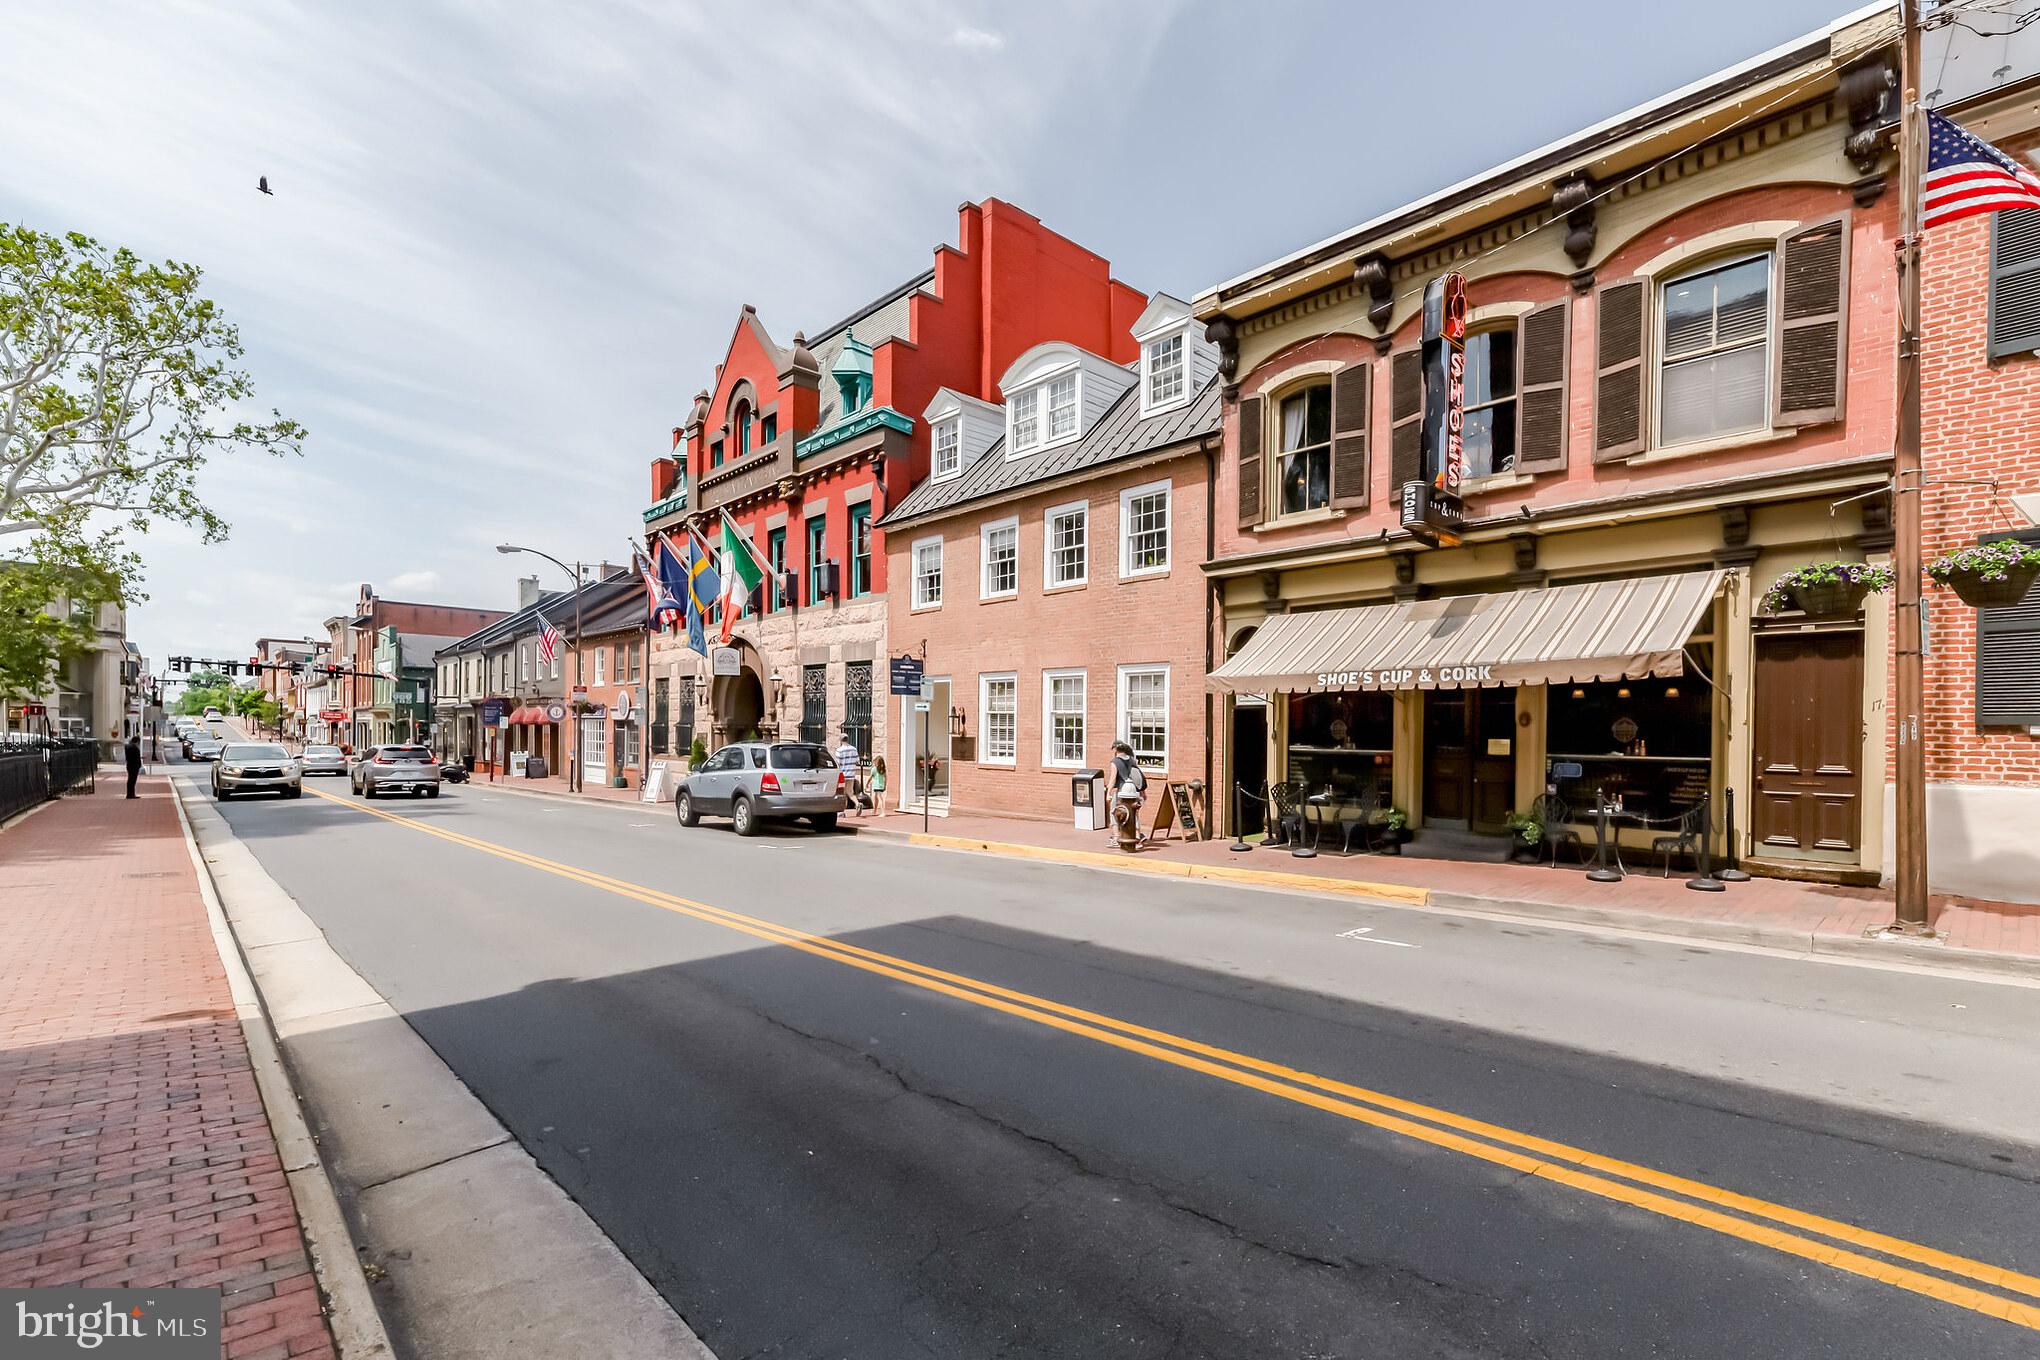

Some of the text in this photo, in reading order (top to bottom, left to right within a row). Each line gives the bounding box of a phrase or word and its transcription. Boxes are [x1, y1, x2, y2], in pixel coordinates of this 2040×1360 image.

[1448, 352, 1466, 487] SHOES
[1404, 486, 1416, 521] SHOES
[1441, 502, 1448, 517] &
[1317, 665, 1491, 686] SHOE'S CUP & CORK
